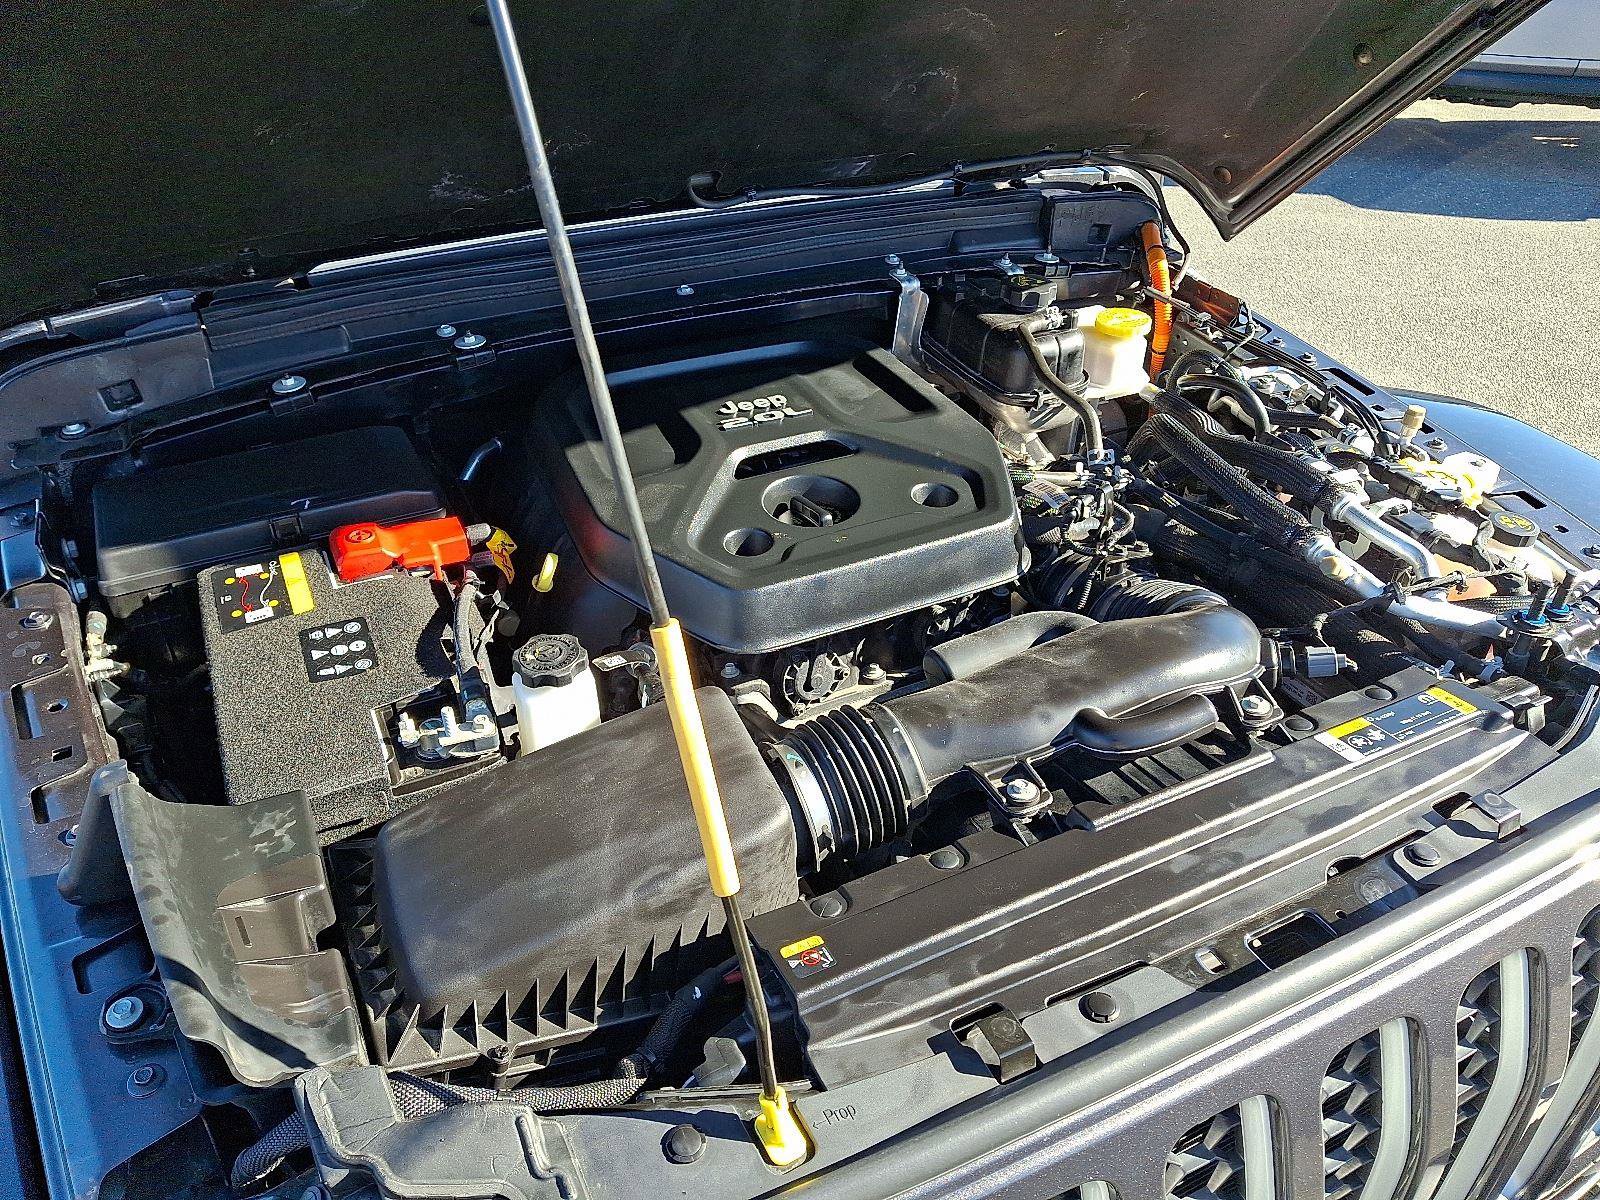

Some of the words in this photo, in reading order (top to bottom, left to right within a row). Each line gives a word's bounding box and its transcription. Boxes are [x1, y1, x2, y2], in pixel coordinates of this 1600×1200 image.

[718, 394, 788, 416] Jeep
[718, 407, 814, 431] 2.0L
[822, 1104, 857, 1126] Prop
